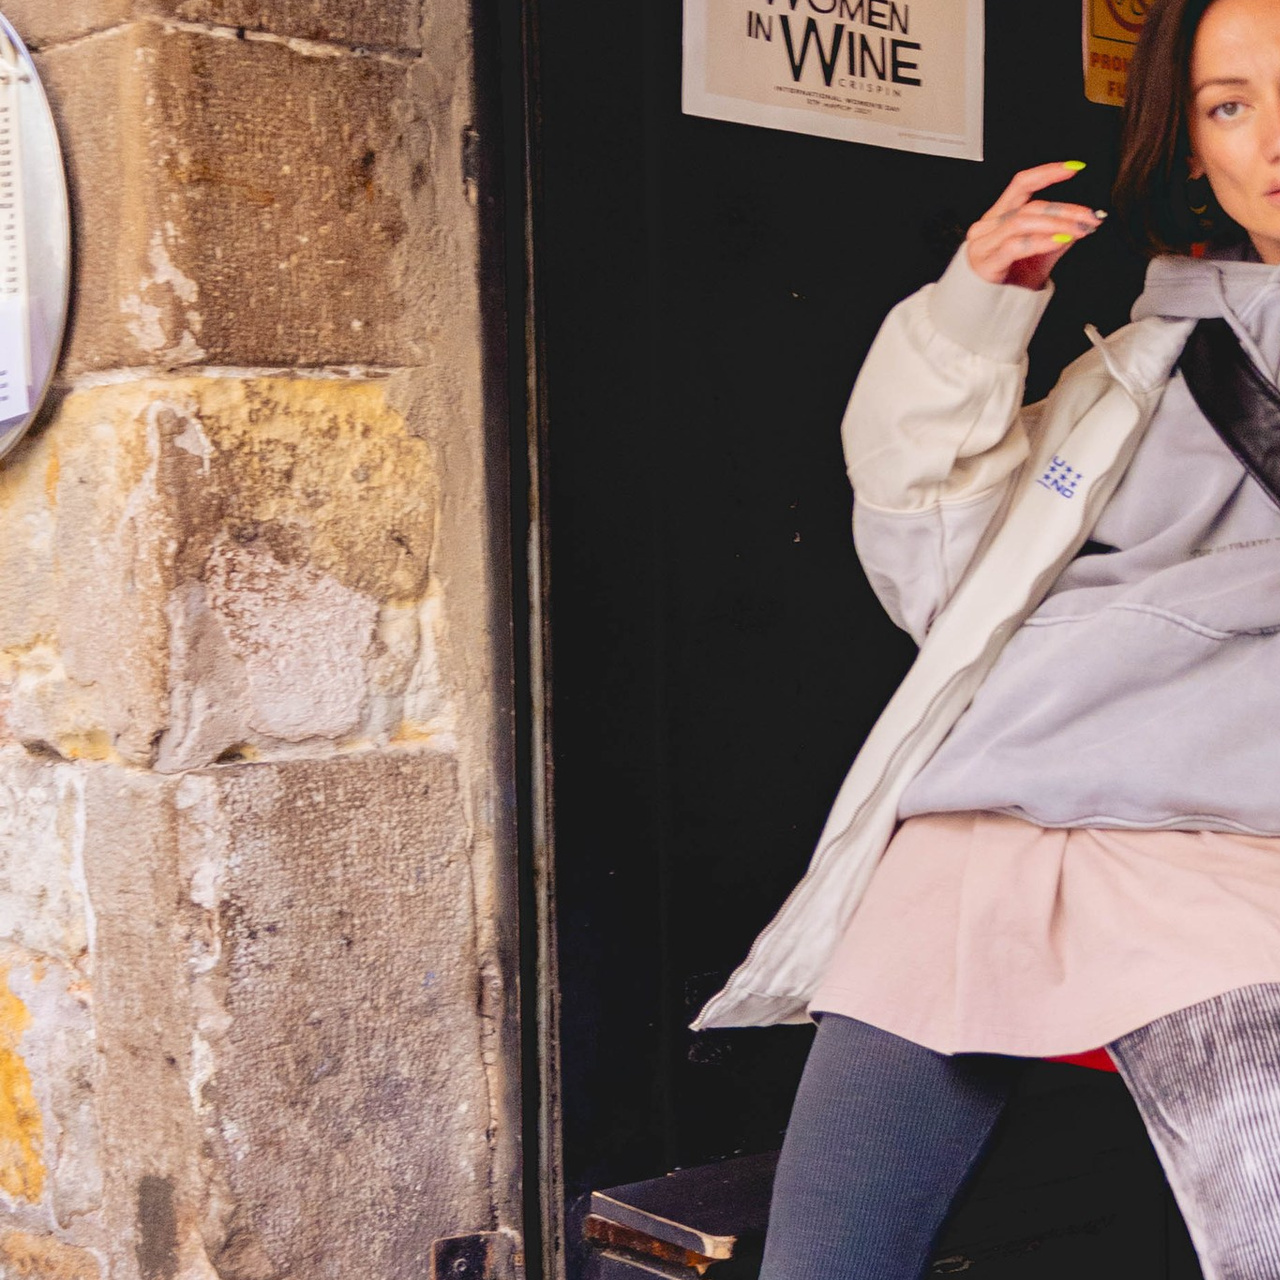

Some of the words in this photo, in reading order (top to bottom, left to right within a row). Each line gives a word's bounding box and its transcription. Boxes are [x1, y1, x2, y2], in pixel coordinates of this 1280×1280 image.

[746, 9, 774, 42] IN
[779, 14, 923, 87] WINE
[838, 78, 903, 99] CRISPIN
